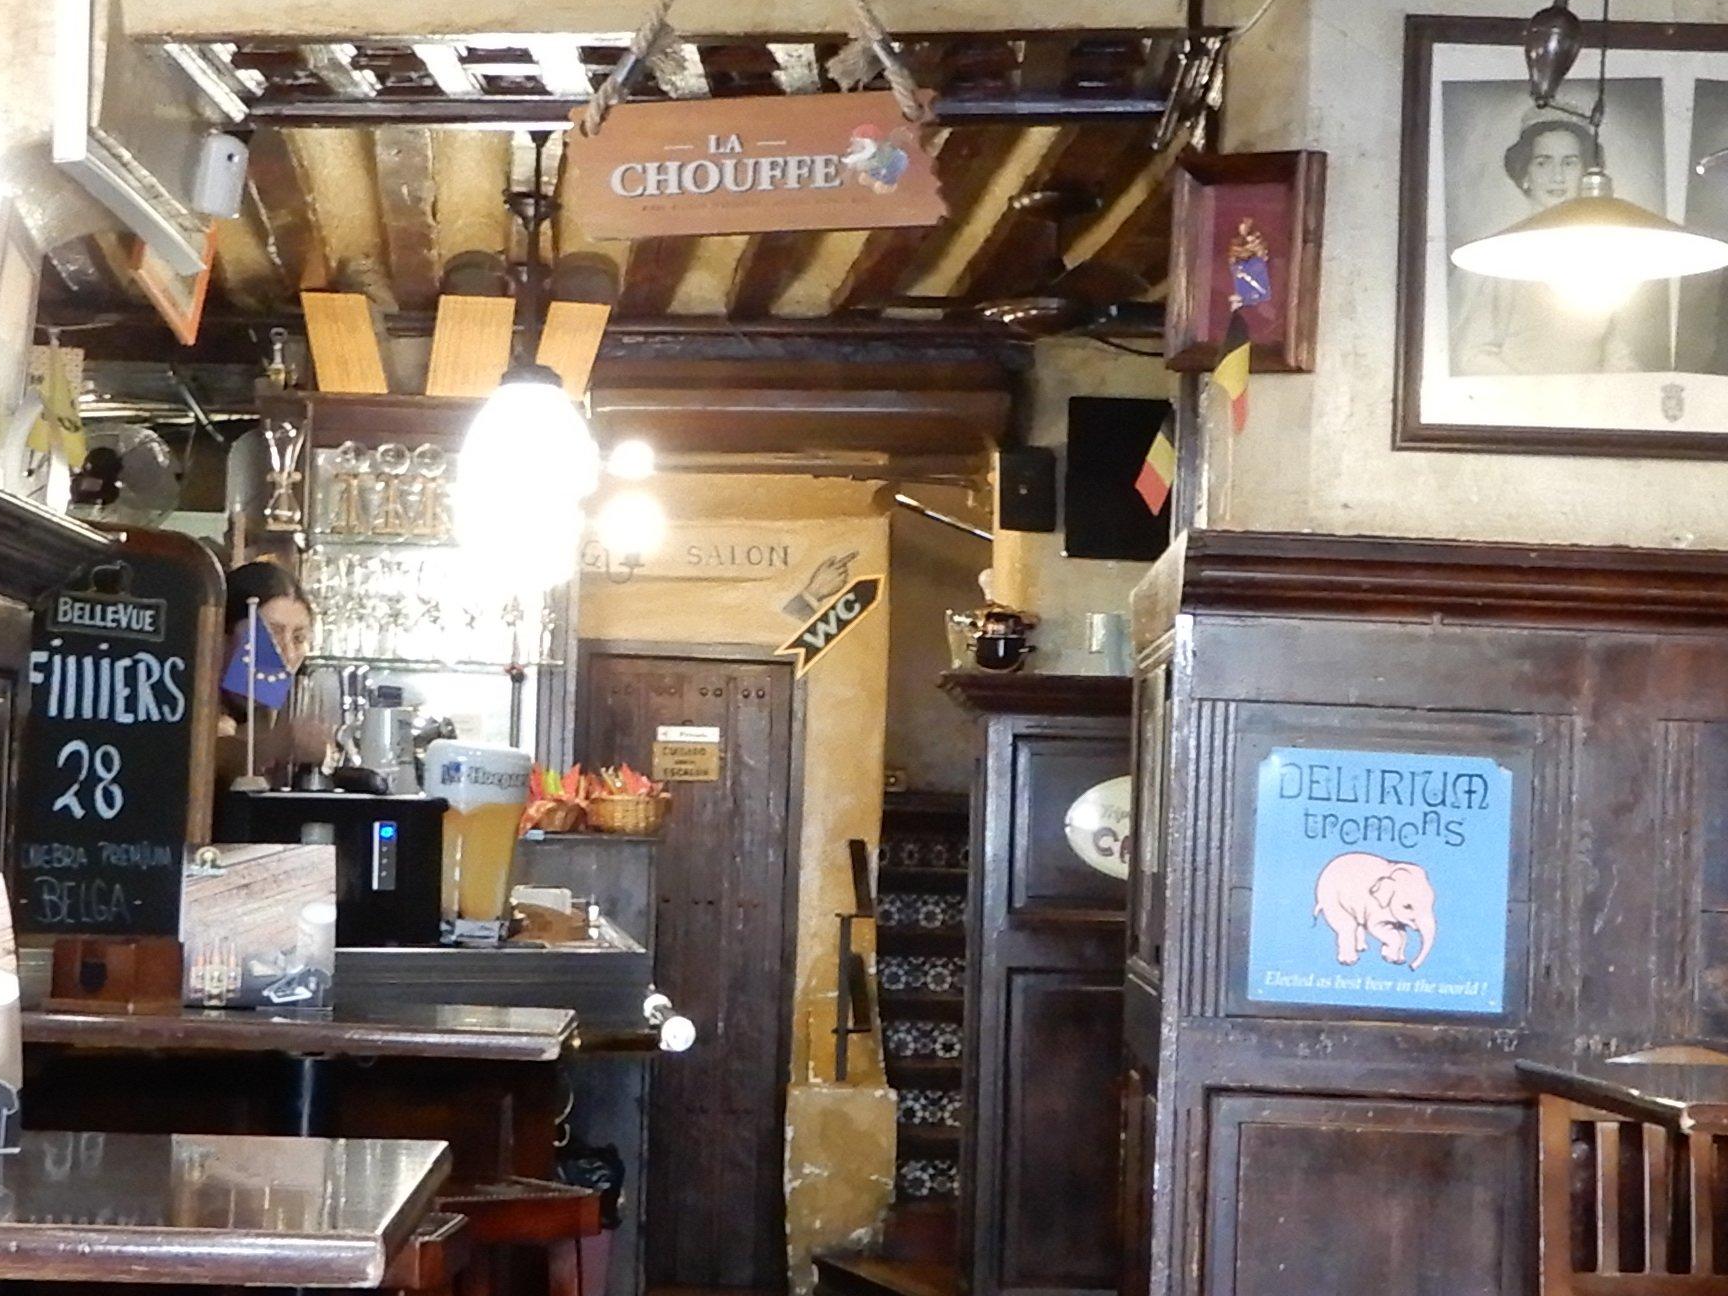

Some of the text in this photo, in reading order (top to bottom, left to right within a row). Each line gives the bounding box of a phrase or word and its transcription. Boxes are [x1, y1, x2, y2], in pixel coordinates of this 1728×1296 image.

[707, 133, 743, 154] LA
[610, 154, 844, 197] CHOUFFE
[802, 590, 864, 649] WC
[52, 738, 125, 821] 28
[1278, 762, 1490, 810] DELIRIUM
[1303, 807, 1466, 849] tremens
[33, 875, 131, 925] BELGA
[1264, 970, 1314, 989] Elected
[1335, 973, 1362, 990] best
[1365, 976, 1392, 991] beer
[1396, 979, 1411, 992] in
[1414, 978, 1435, 993] the
